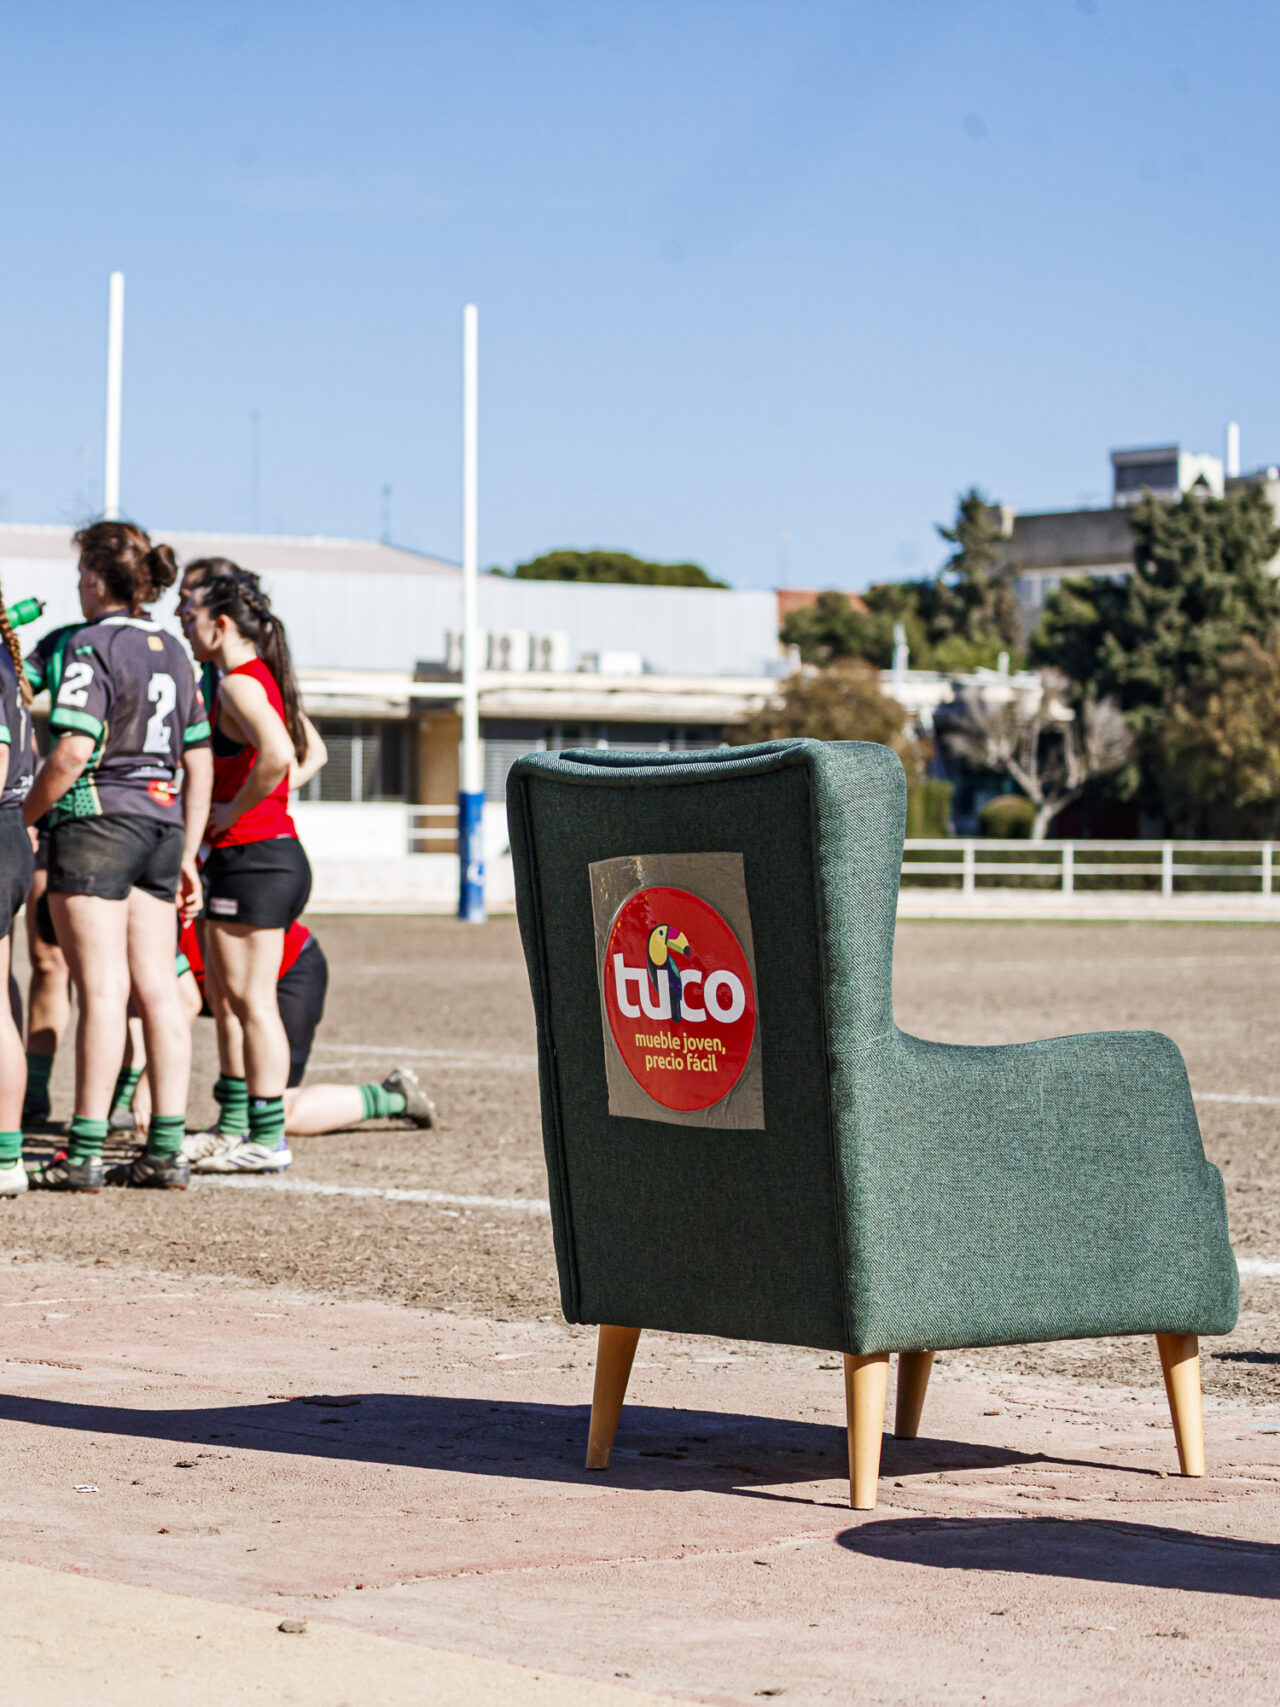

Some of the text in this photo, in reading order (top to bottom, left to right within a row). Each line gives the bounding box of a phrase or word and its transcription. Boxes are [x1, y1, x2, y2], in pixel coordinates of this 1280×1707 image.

[57, 662, 94, 708] 2
[143, 672, 177, 754] 2
[613, 953, 746, 1024] tuco
[635, 1031, 726, 1055] mueble joven,
[645, 1052, 718, 1072] precio fácil
